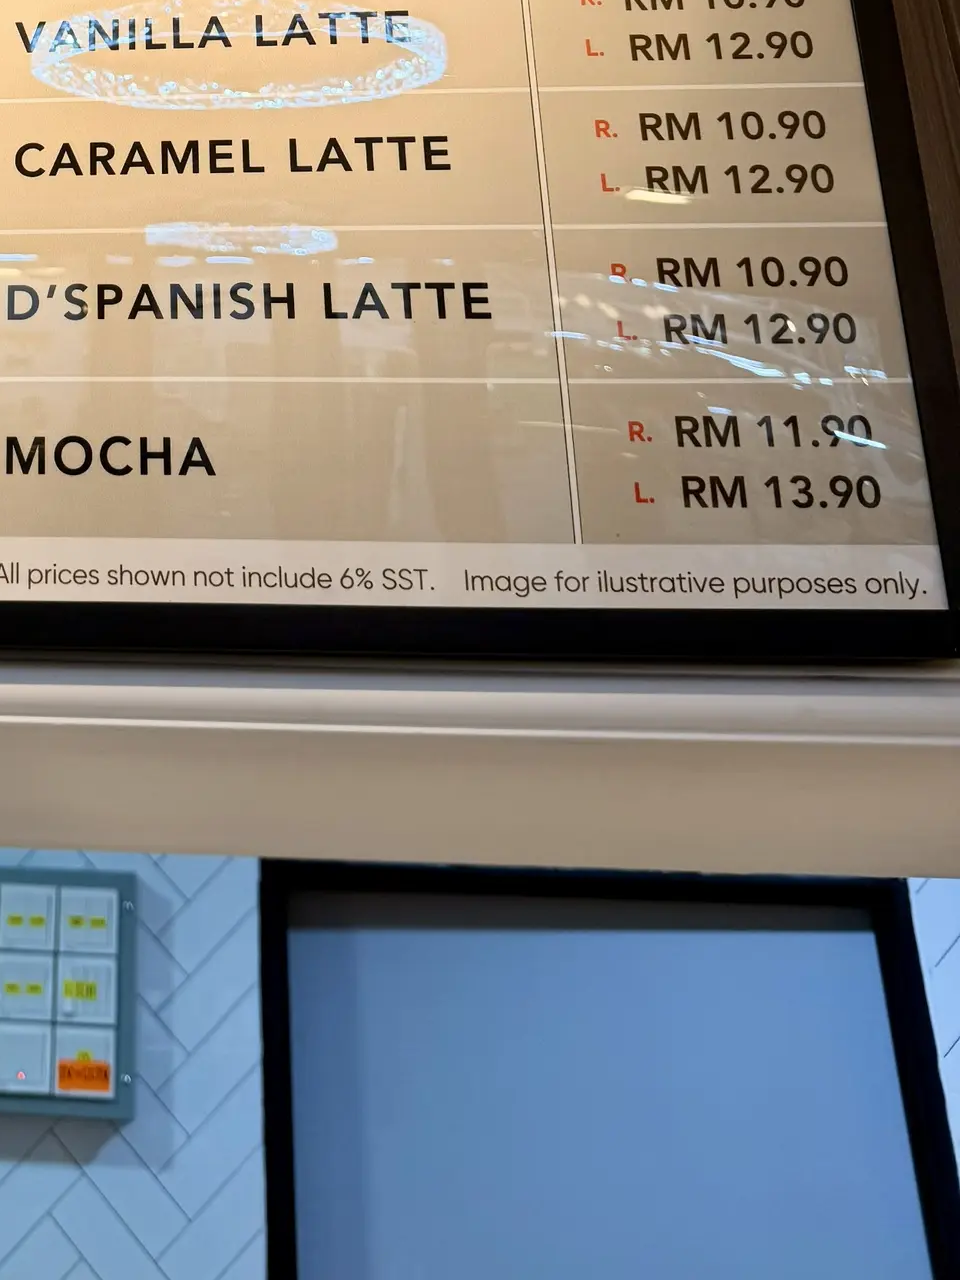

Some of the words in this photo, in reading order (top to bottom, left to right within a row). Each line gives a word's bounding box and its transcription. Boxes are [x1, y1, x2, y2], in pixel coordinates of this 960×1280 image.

[15, 16, 232, 53] VANILLA
[255, 11, 411, 47] LATTE
[585, 40, 604, 56] L.
[629, 34, 690, 61] RM
[705, 31, 813, 60] 12.90
[595, 120, 618, 138] R.
[639, 113, 701, 140] RM
[717, 110, 826, 140] 10.90
[14, 139, 264, 178] CARAMEL
[289, 136, 451, 173] LATTE
[600, 174, 620, 192] L.
[645, 166, 708, 193] RM
[724, 164, 834, 193] 12.90
[656, 257, 720, 287] RM
[737, 256, 848, 287] 10.90
[7, 283, 295, 321] D'SPANISH
[323, 282, 492, 319] LATTE
[617, 321, 638, 340] L.
[663, 314, 728, 344] RM
[743, 312, 857, 344] 12.90
[628, 421, 652, 441] R.
[674, 416, 740, 447] RM
[757, 415, 872, 448] 11.90
[5, 436, 216, 476] MOCHA
[634, 482, 655, 503] L.
[681, 476, 747, 508] RM
[764, 475, 881, 508] 13.90
[28, 563, 99, 590] prices
[107, 565, 186, 586] shown
[193, 567, 234, 587] not
[242, 566, 332, 589] include
[340, 567, 373, 590] 6%
[383, 568, 435, 591] SST.
[464, 570, 547, 597] Image
[554, 571, 589, 593] for
[597, 570, 725, 593] ilustrative
[733, 573, 857, 599] purposes
[865, 571, 927, 599] only.
